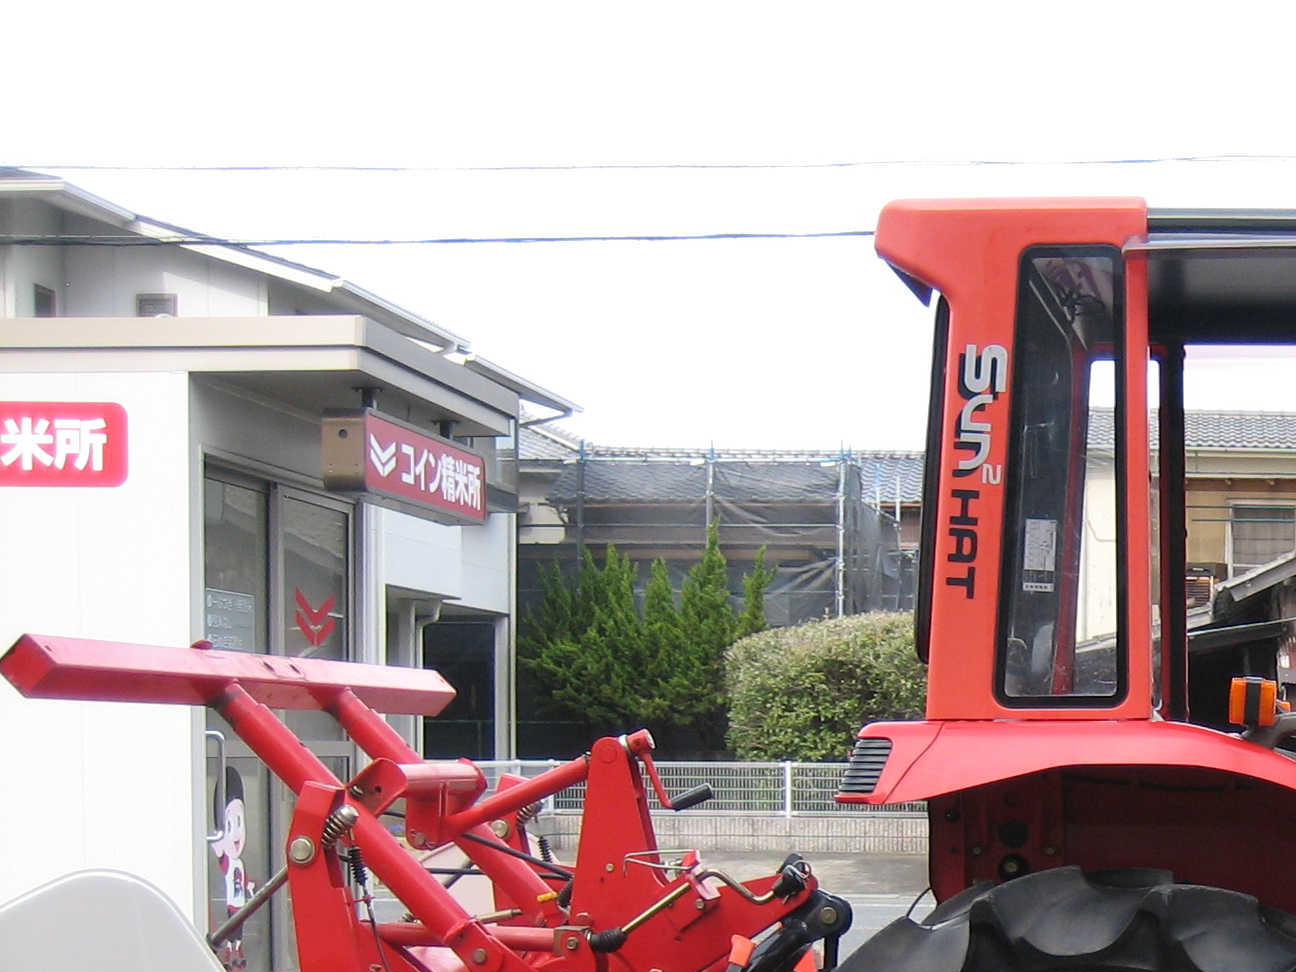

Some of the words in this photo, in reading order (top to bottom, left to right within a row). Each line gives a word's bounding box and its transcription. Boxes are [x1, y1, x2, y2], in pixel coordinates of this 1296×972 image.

[0, 417, 108, 471] 米所
[401, 443, 481, 511] コイン精米所
[946, 489, 980, 599] HAT
